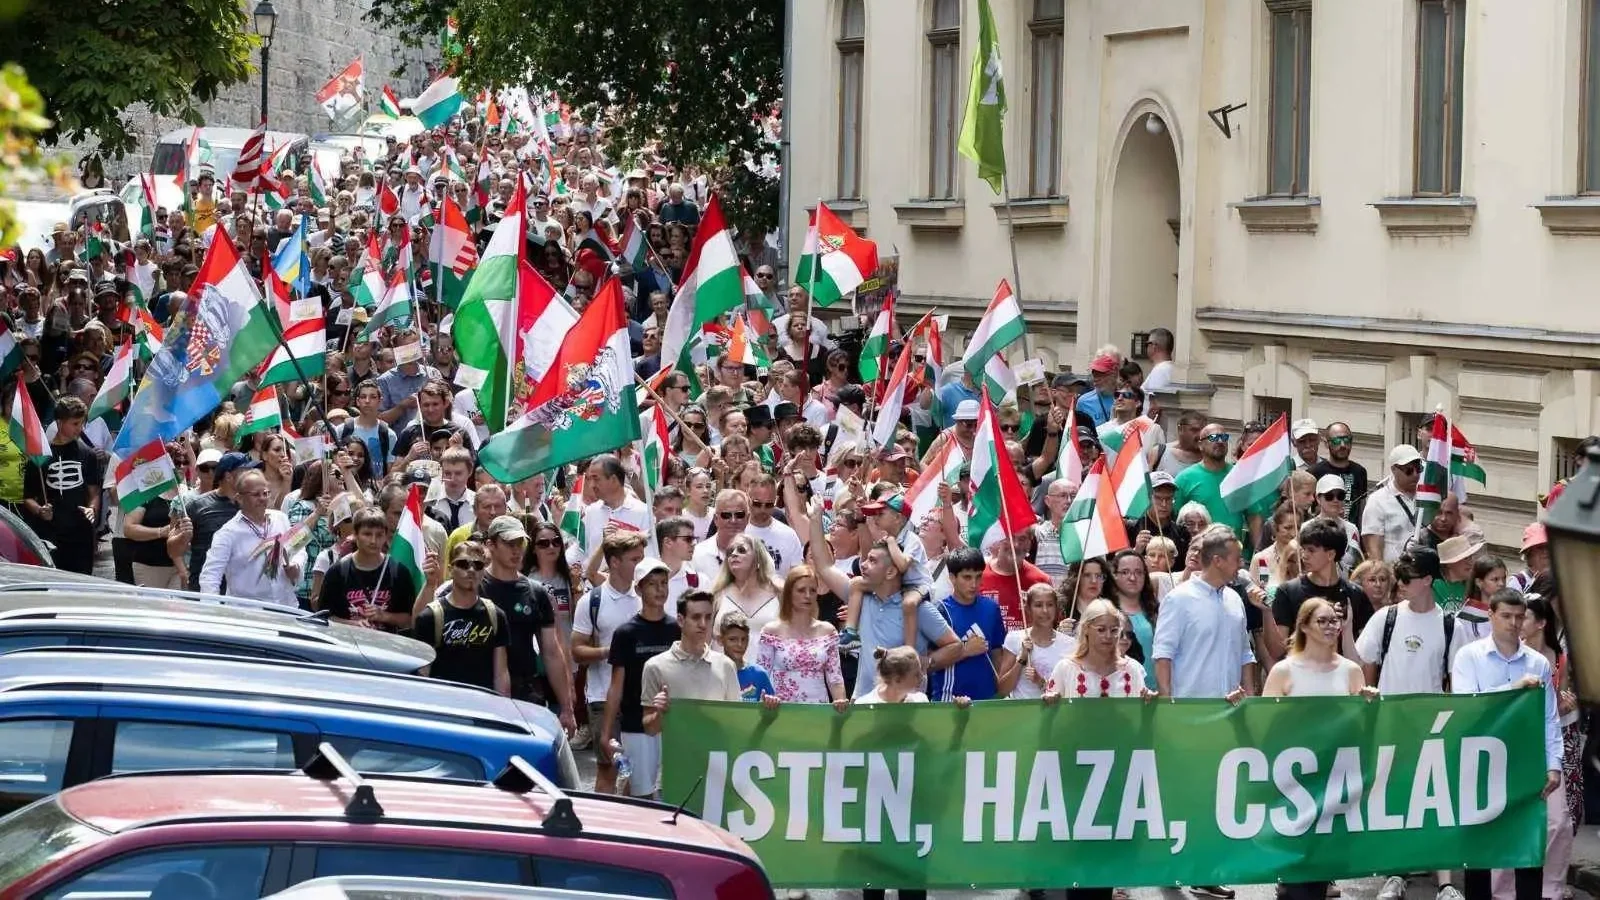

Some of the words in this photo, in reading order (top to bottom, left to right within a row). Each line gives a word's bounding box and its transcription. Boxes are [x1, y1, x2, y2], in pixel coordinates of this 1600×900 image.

[702, 751, 933, 858] ISTEN,
[963, 750, 1187, 854] HAZA,
[1215, 711, 1508, 840] CSALÁD
